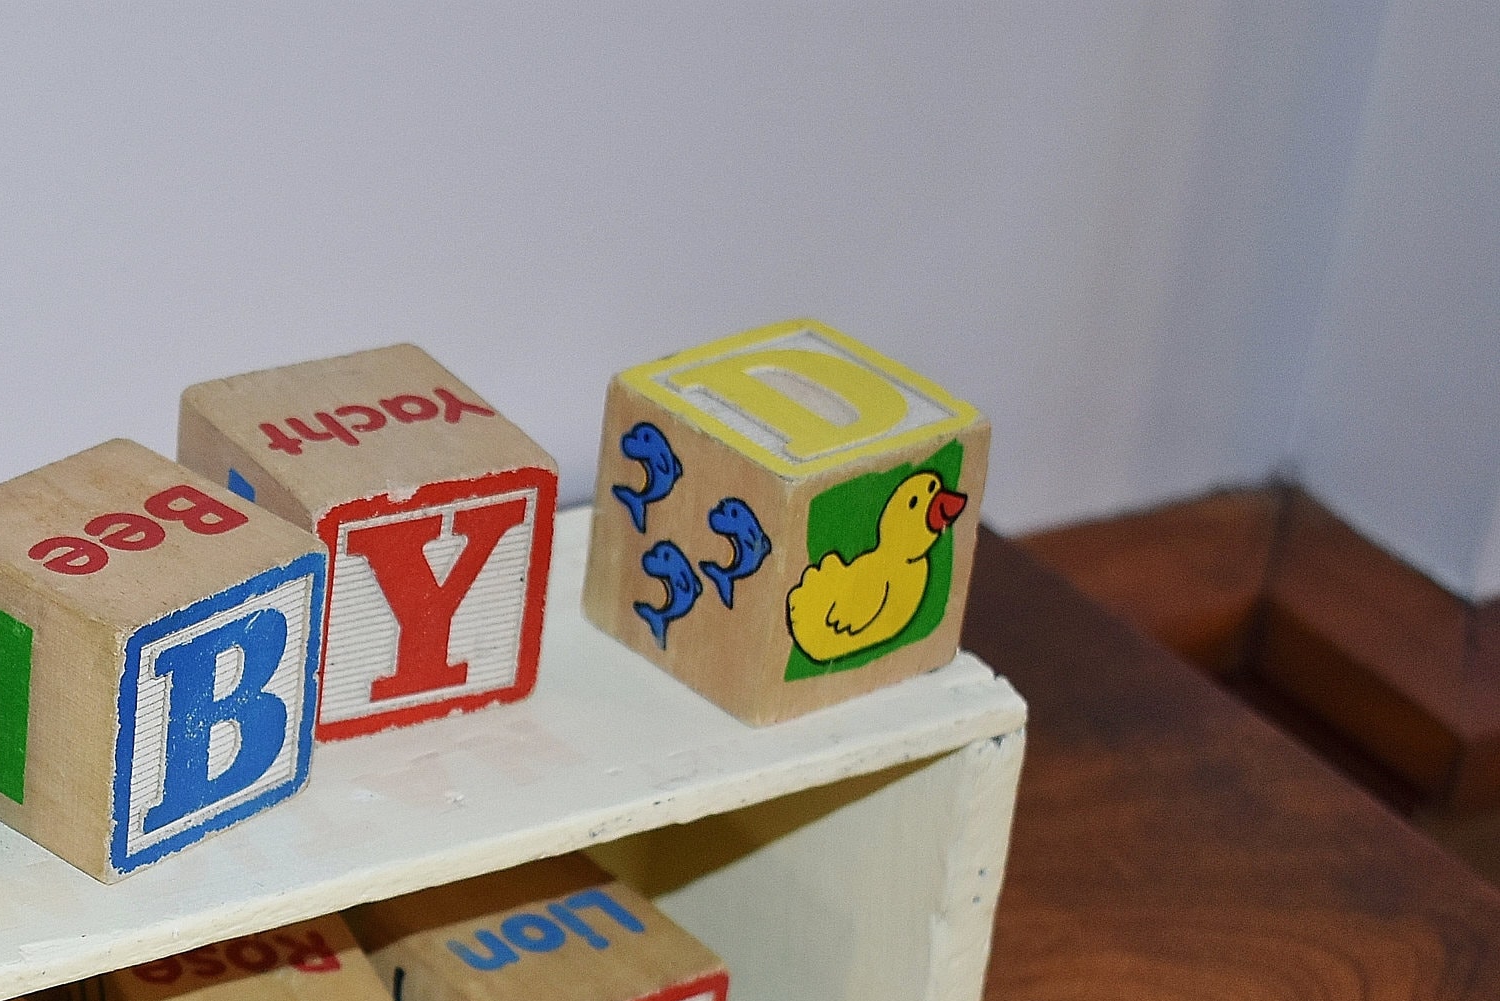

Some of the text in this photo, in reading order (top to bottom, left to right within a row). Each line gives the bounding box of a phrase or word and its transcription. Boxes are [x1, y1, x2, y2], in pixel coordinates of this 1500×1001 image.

[260, 386, 496, 456] Yacht
[665, 348, 909, 458] D
[28, 484, 249, 576] Bee
[347, 497, 527, 702] Y
[142, 607, 288, 834] B
[131, 930, 342, 984] Rose
[446, 887, 647, 972] Lion
